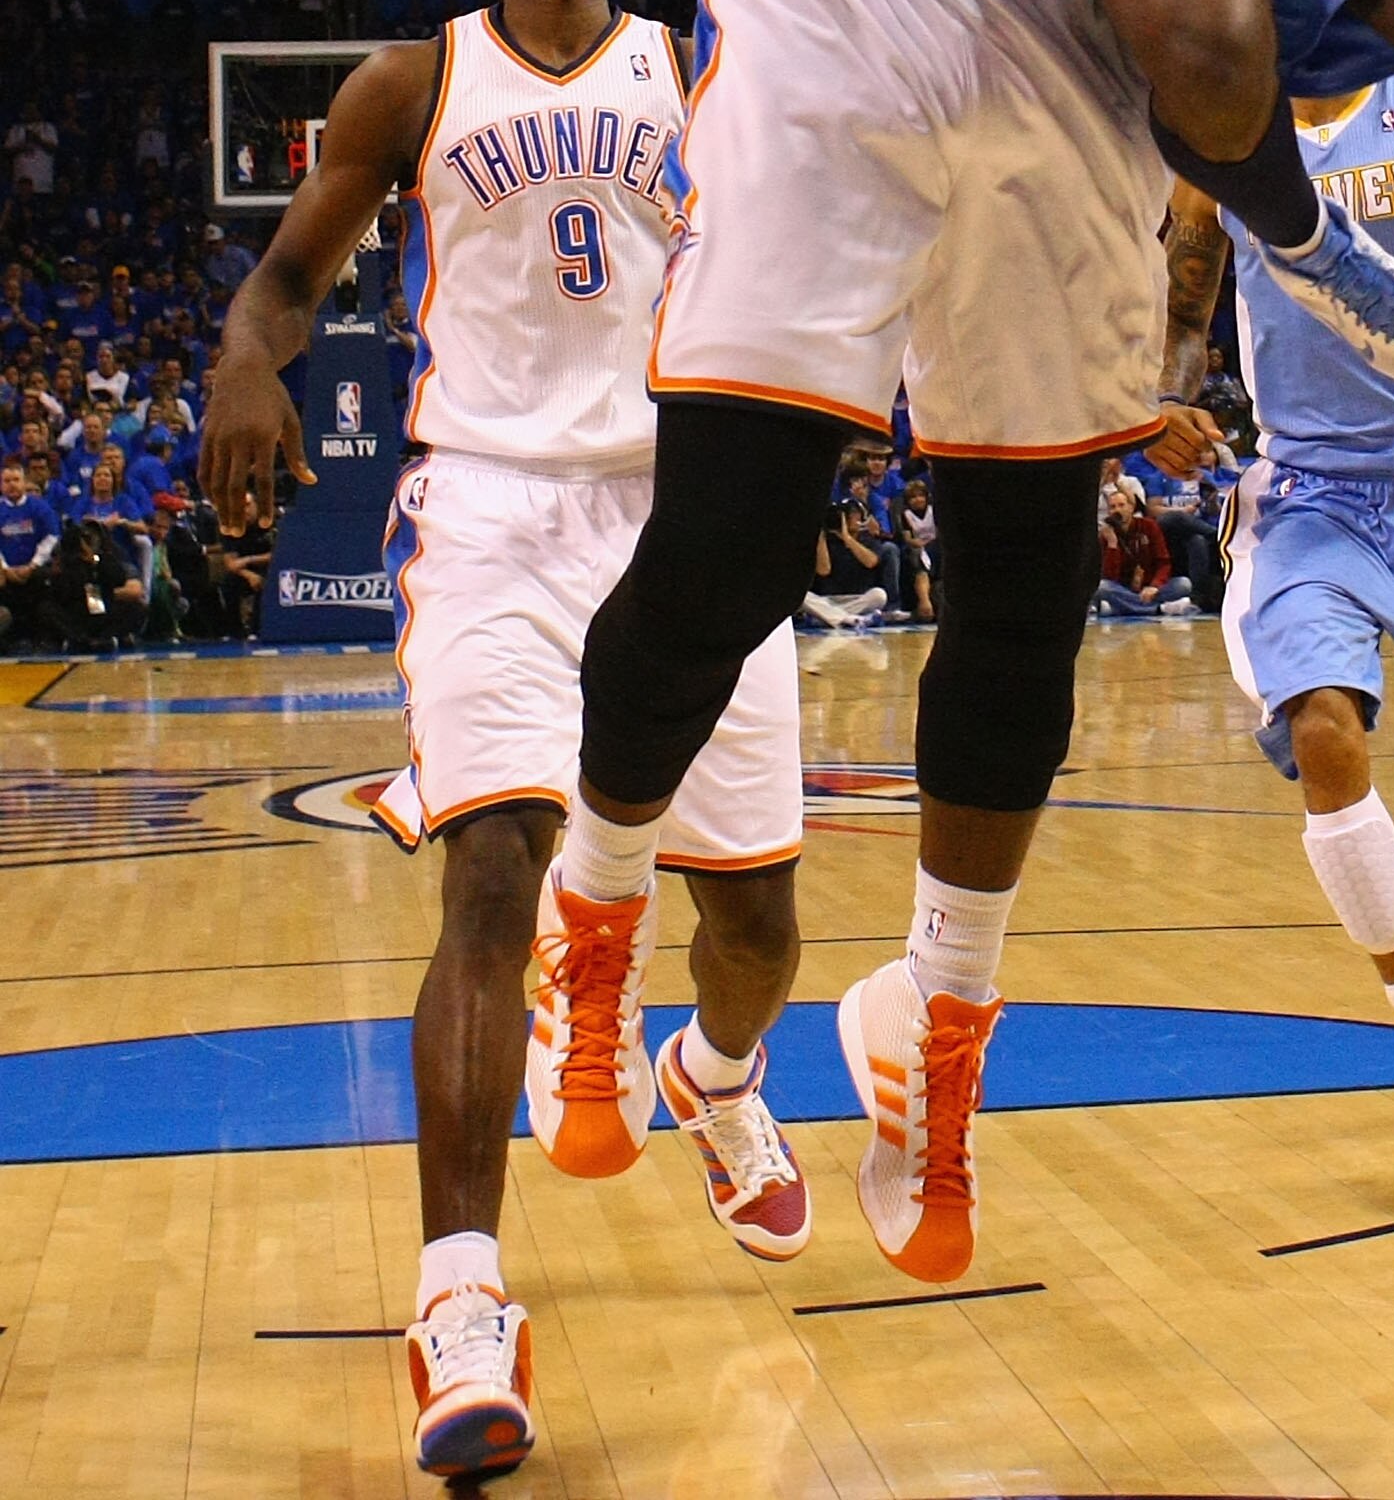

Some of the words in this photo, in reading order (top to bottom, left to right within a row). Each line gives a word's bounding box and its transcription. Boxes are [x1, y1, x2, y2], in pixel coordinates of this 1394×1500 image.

[549, 199, 610, 301] 9
[321, 439, 357, 458] NBA
[357, 439, 378, 458] TV
